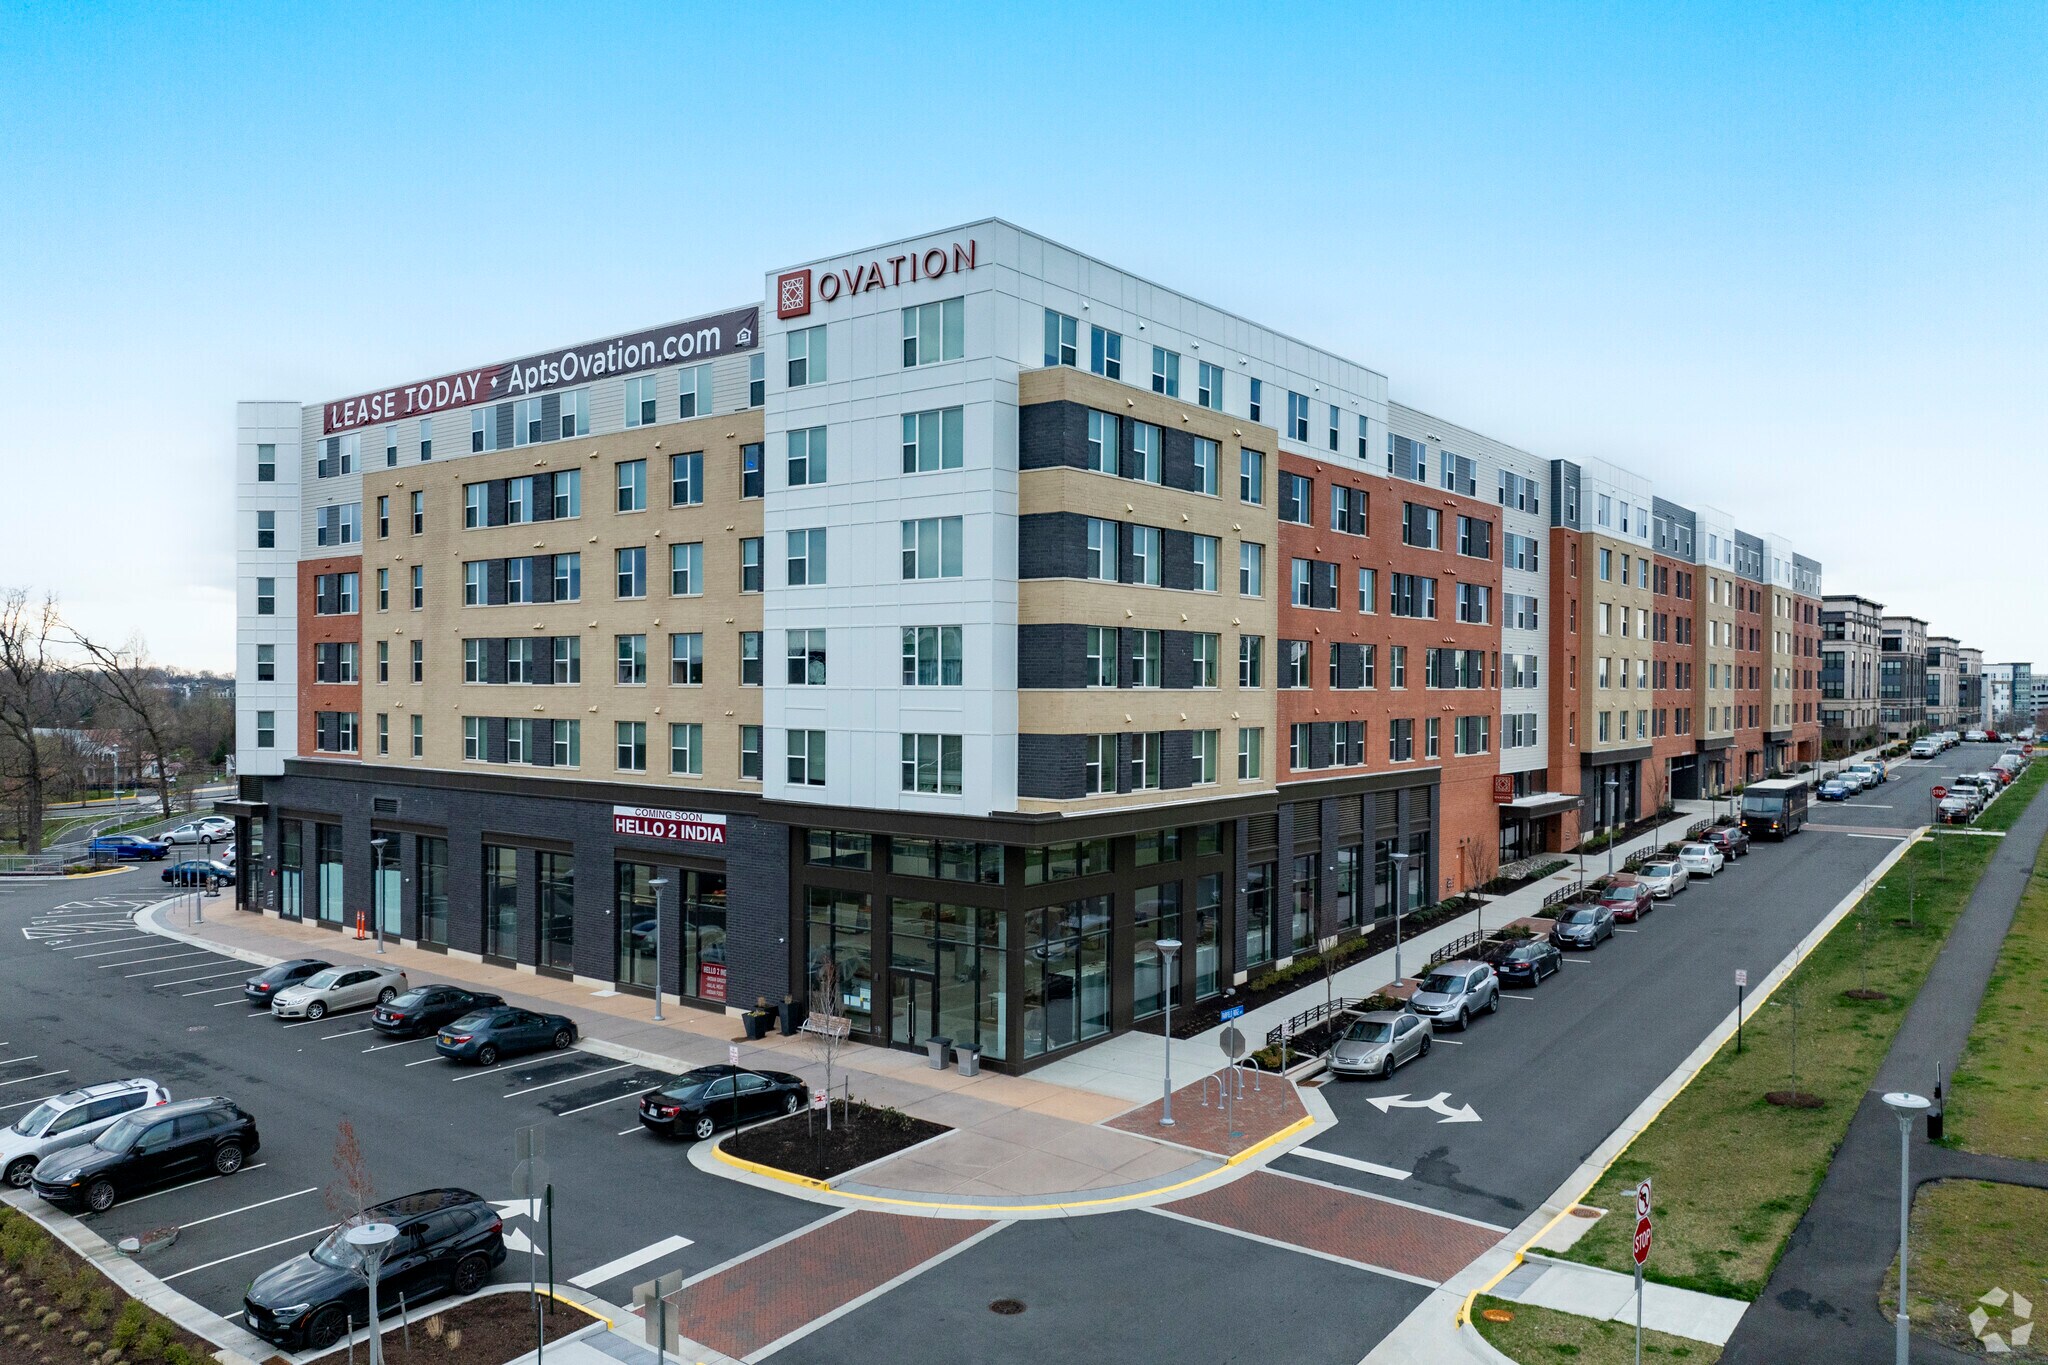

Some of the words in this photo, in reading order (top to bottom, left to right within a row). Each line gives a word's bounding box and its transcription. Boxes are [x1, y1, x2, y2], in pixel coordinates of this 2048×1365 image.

[817, 239, 976, 302] OVATION
[332, 391, 396, 429] LEASE
[404, 372, 481, 413] TODAY
[507, 326, 721, 394] AptsOvation.com
[635, 808, 672, 819] COMING
[674, 811, 703, 822] SOON
[615, 818, 664, 837] HELLO
[668, 824, 677, 838] 2
[681, 825, 723, 843] INDIA
[703, 966, 716, 975] HELLO
[1635, 1229, 1650, 1253] STOP
